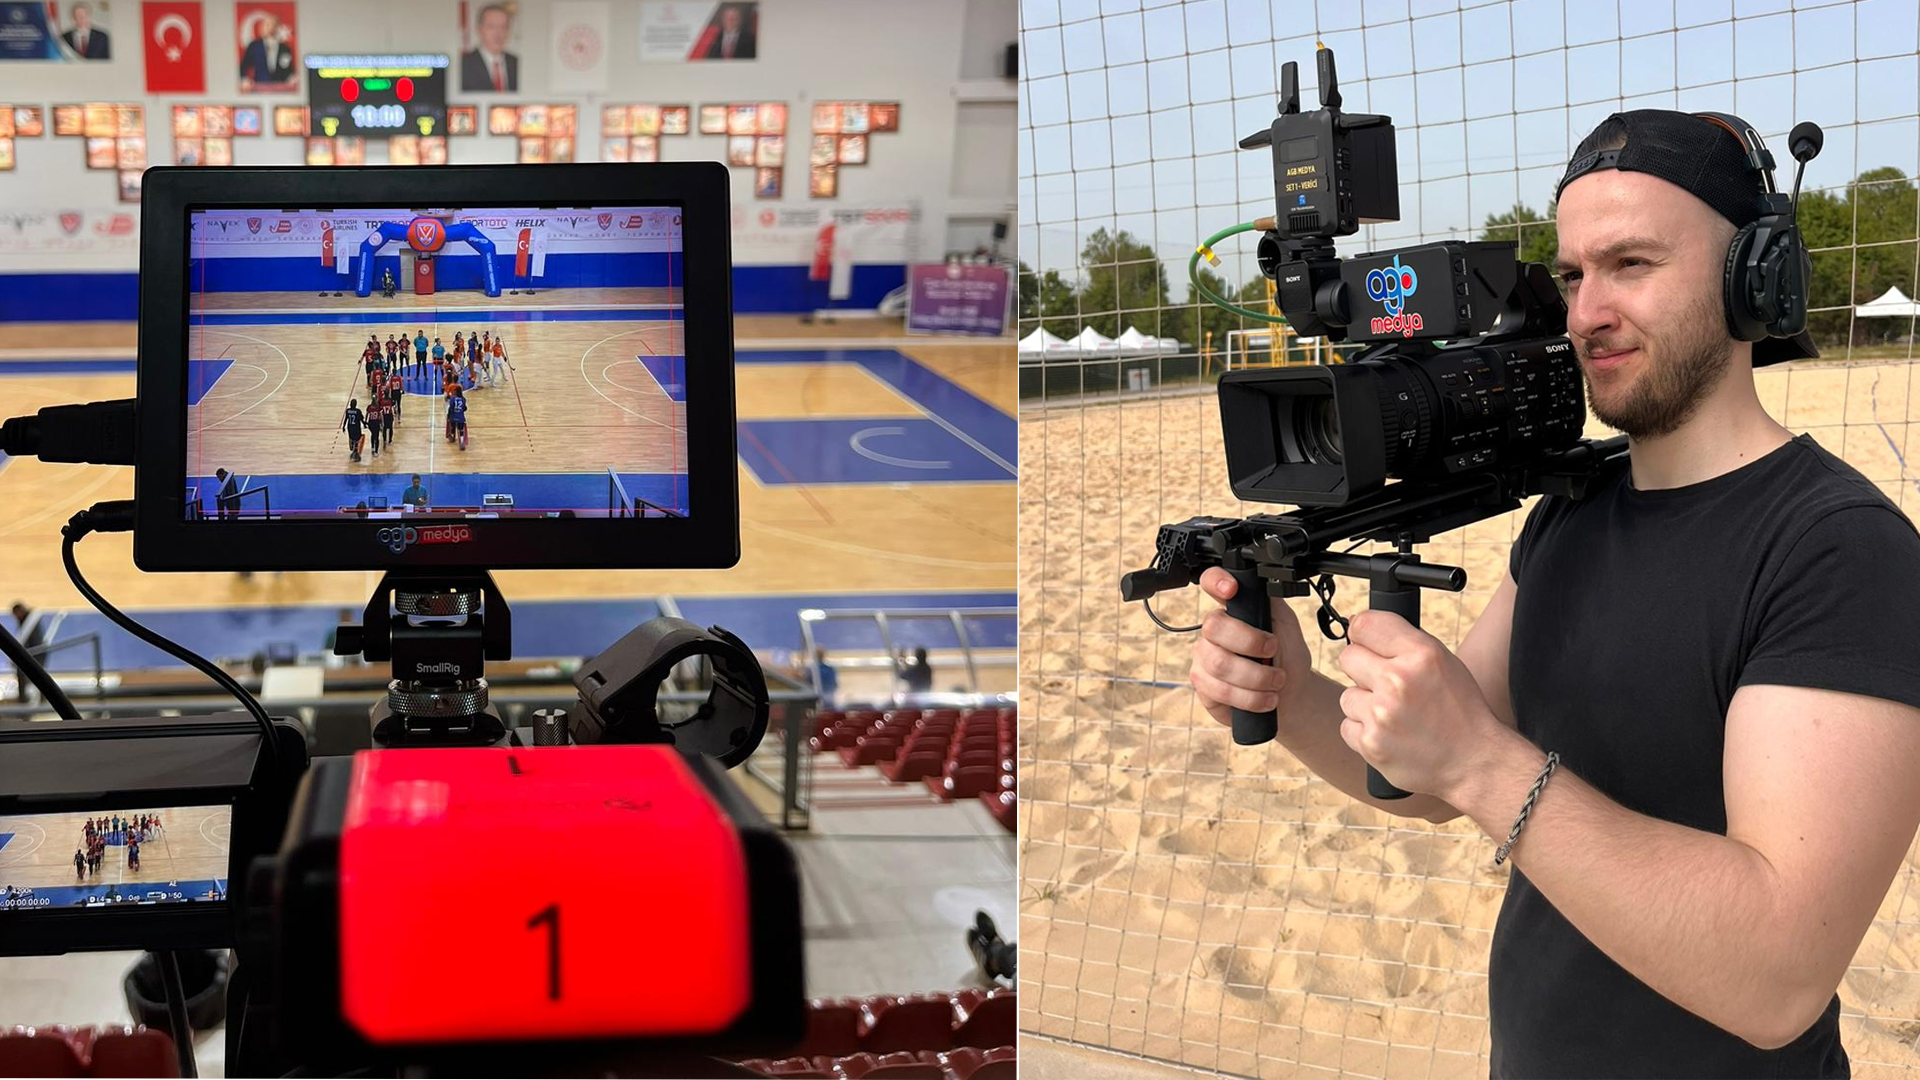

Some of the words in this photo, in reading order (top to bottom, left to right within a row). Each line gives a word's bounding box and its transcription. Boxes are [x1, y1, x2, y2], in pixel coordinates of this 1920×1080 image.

[515, 219, 546, 227] HELIX
[1285, 275, 1301, 283] SONY
[1371, 308, 1424, 338] medya
[1545, 343, 1570, 353] SONY
[454, 400, 463, 410] 12
[348, 414, 356, 425] 12
[423, 525, 469, 543] medya
[416, 662, 461, 676] SmallRig
[526, 902, 563, 1002] 1
